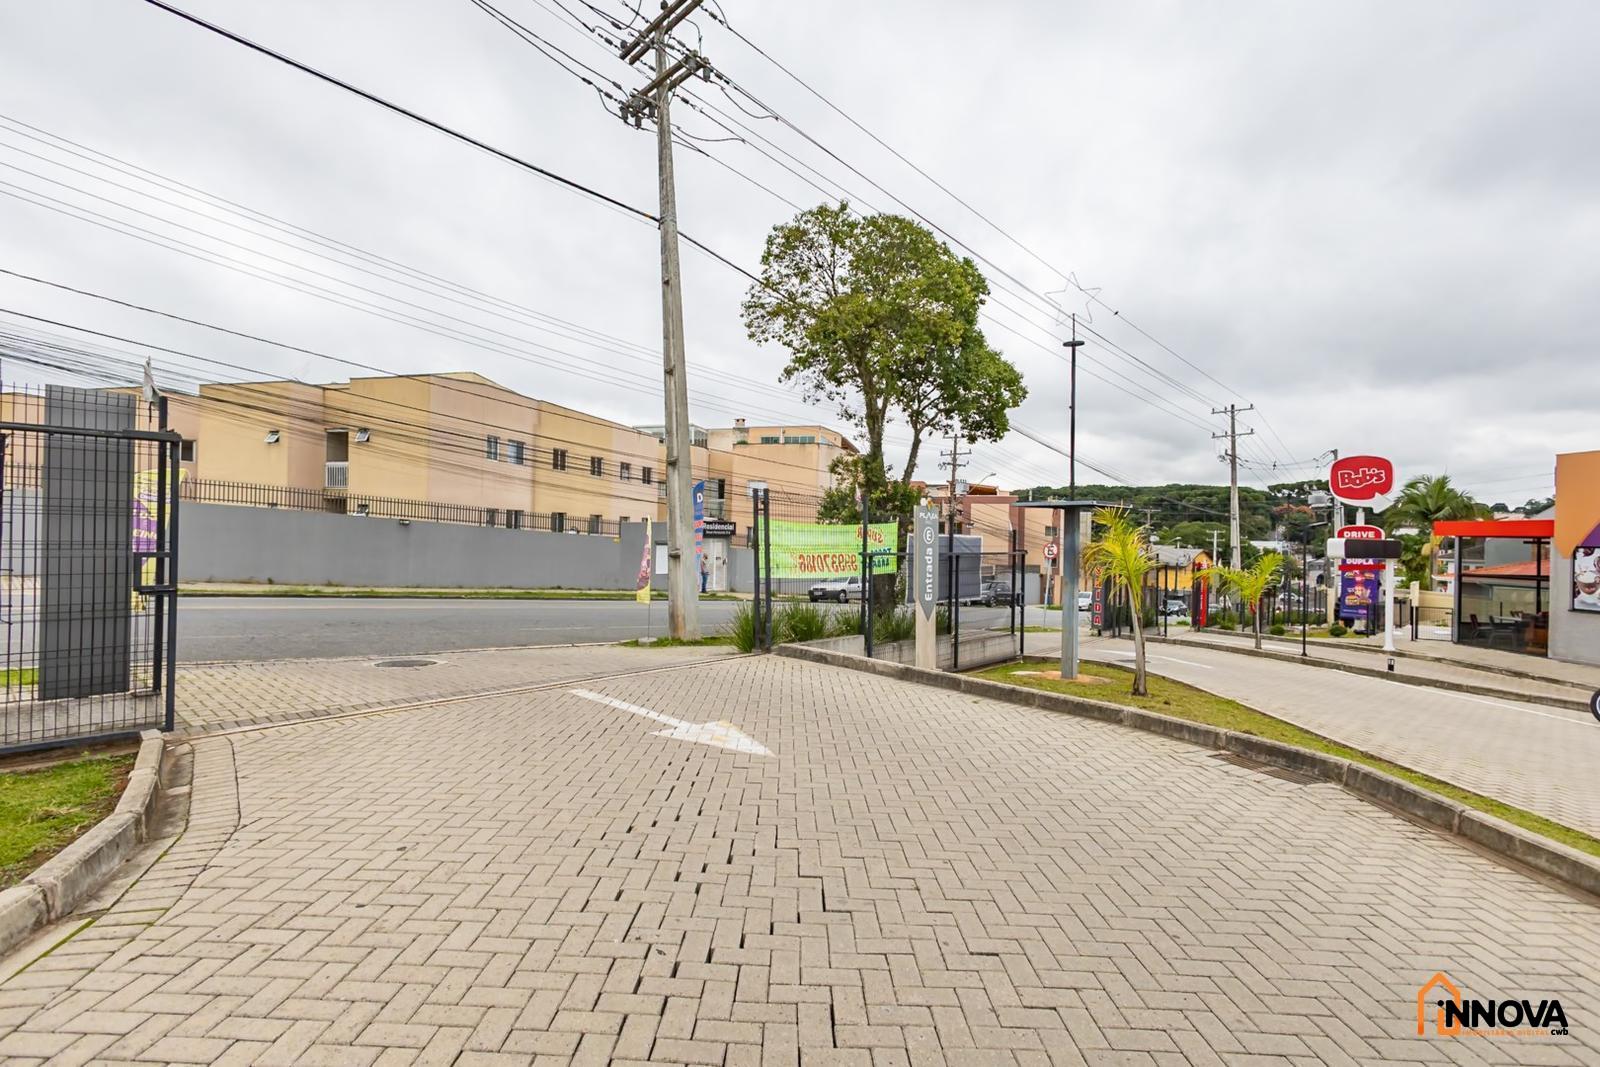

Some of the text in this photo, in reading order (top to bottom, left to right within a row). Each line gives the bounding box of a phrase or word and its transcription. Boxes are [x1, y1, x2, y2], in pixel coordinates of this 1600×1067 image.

[1338, 467, 1386, 489] Bob's
[703, 522, 735, 531] Residencial
[924, 547, 933, 601] Entrada
